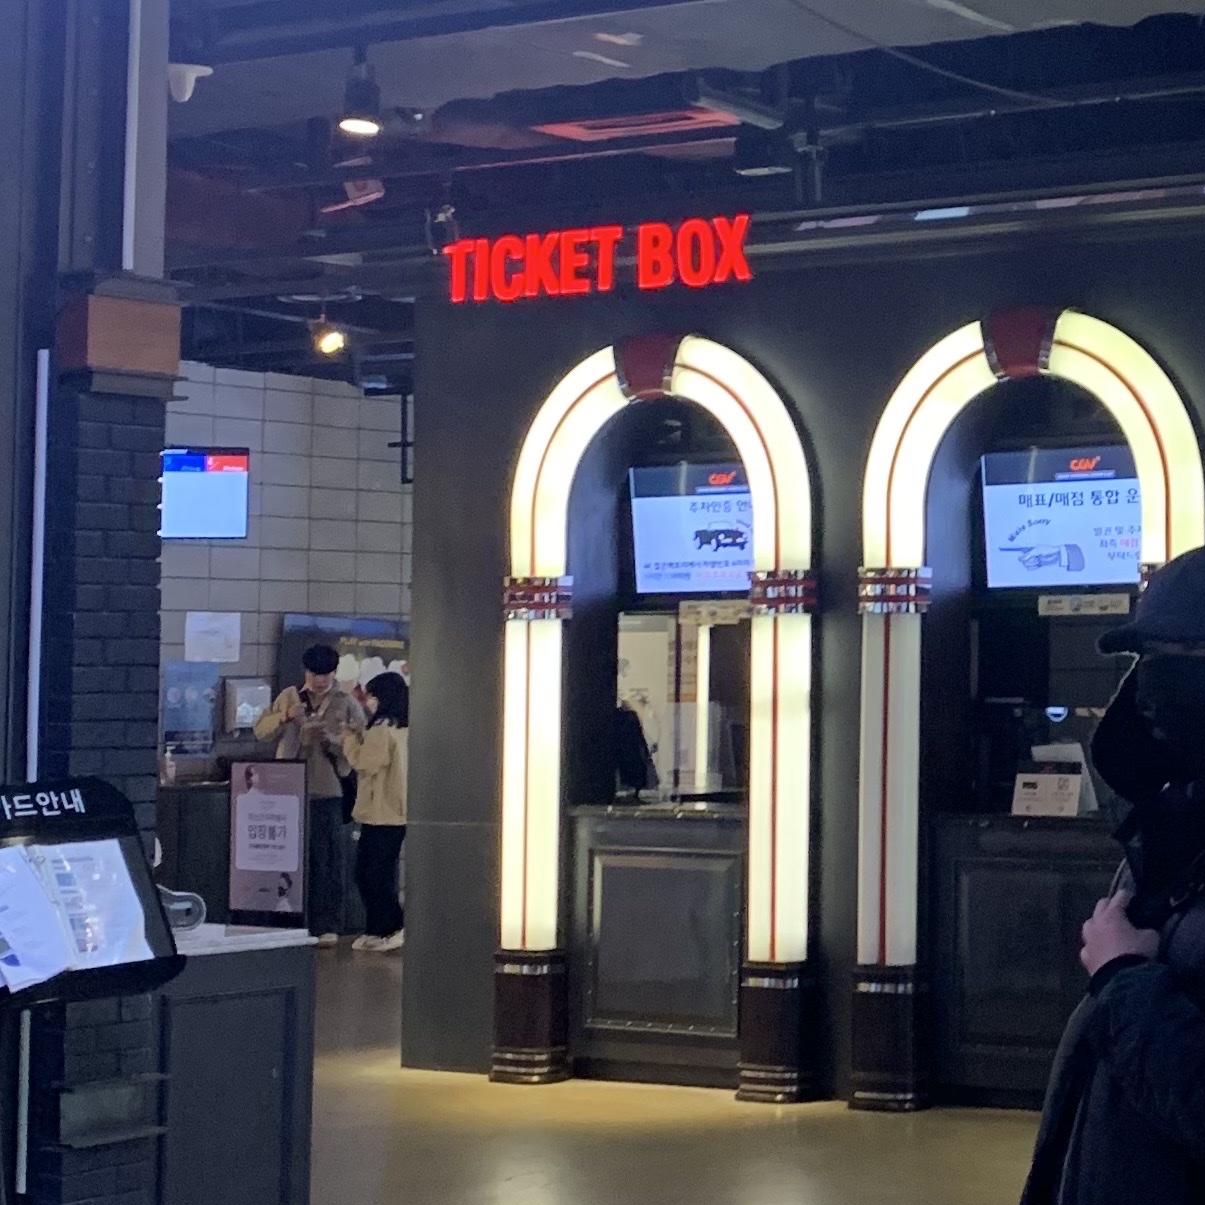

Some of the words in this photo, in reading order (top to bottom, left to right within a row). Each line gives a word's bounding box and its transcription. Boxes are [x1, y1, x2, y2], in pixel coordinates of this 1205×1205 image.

[442, 225, 623, 303] TICKET
[637, 212, 753, 289] BOX
[1018, 491, 1084, 508] 매표/매점
[1090, 489, 1120, 506] 통합
[247, 824, 287, 841] 입장불가
